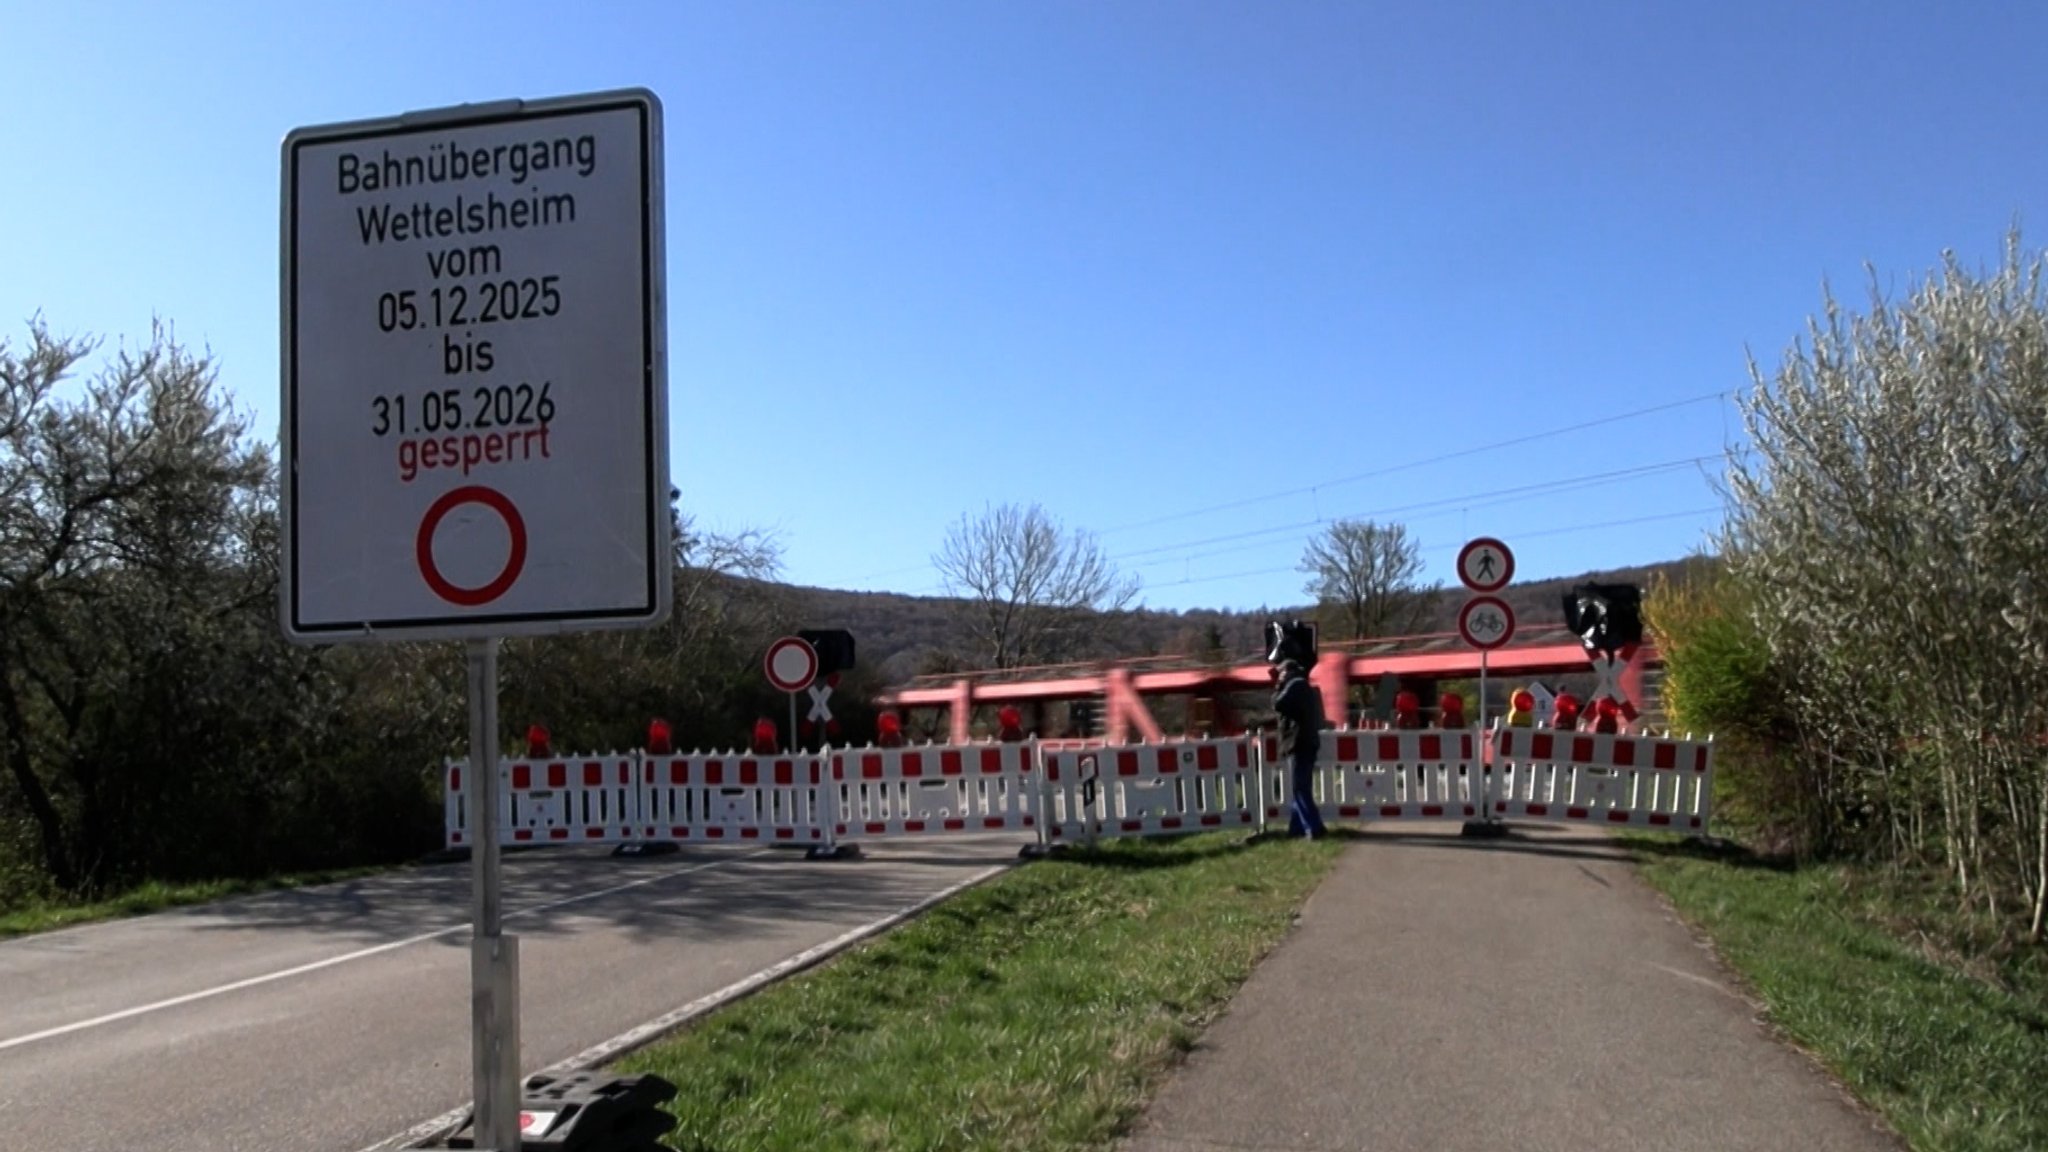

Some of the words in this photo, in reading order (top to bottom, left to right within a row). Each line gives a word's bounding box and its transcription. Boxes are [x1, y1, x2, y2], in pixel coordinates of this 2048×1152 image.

[338, 134, 596, 194] Bahnübergang
[356, 187, 576, 245] Wettelsheim
[426, 244, 502, 279] vom
[378, 275, 561, 333] 05.12.2025
[443, 331, 495, 374] bis
[371, 382, 556, 436] 31.05.2026
[399, 421, 551, 481] gesperrt
